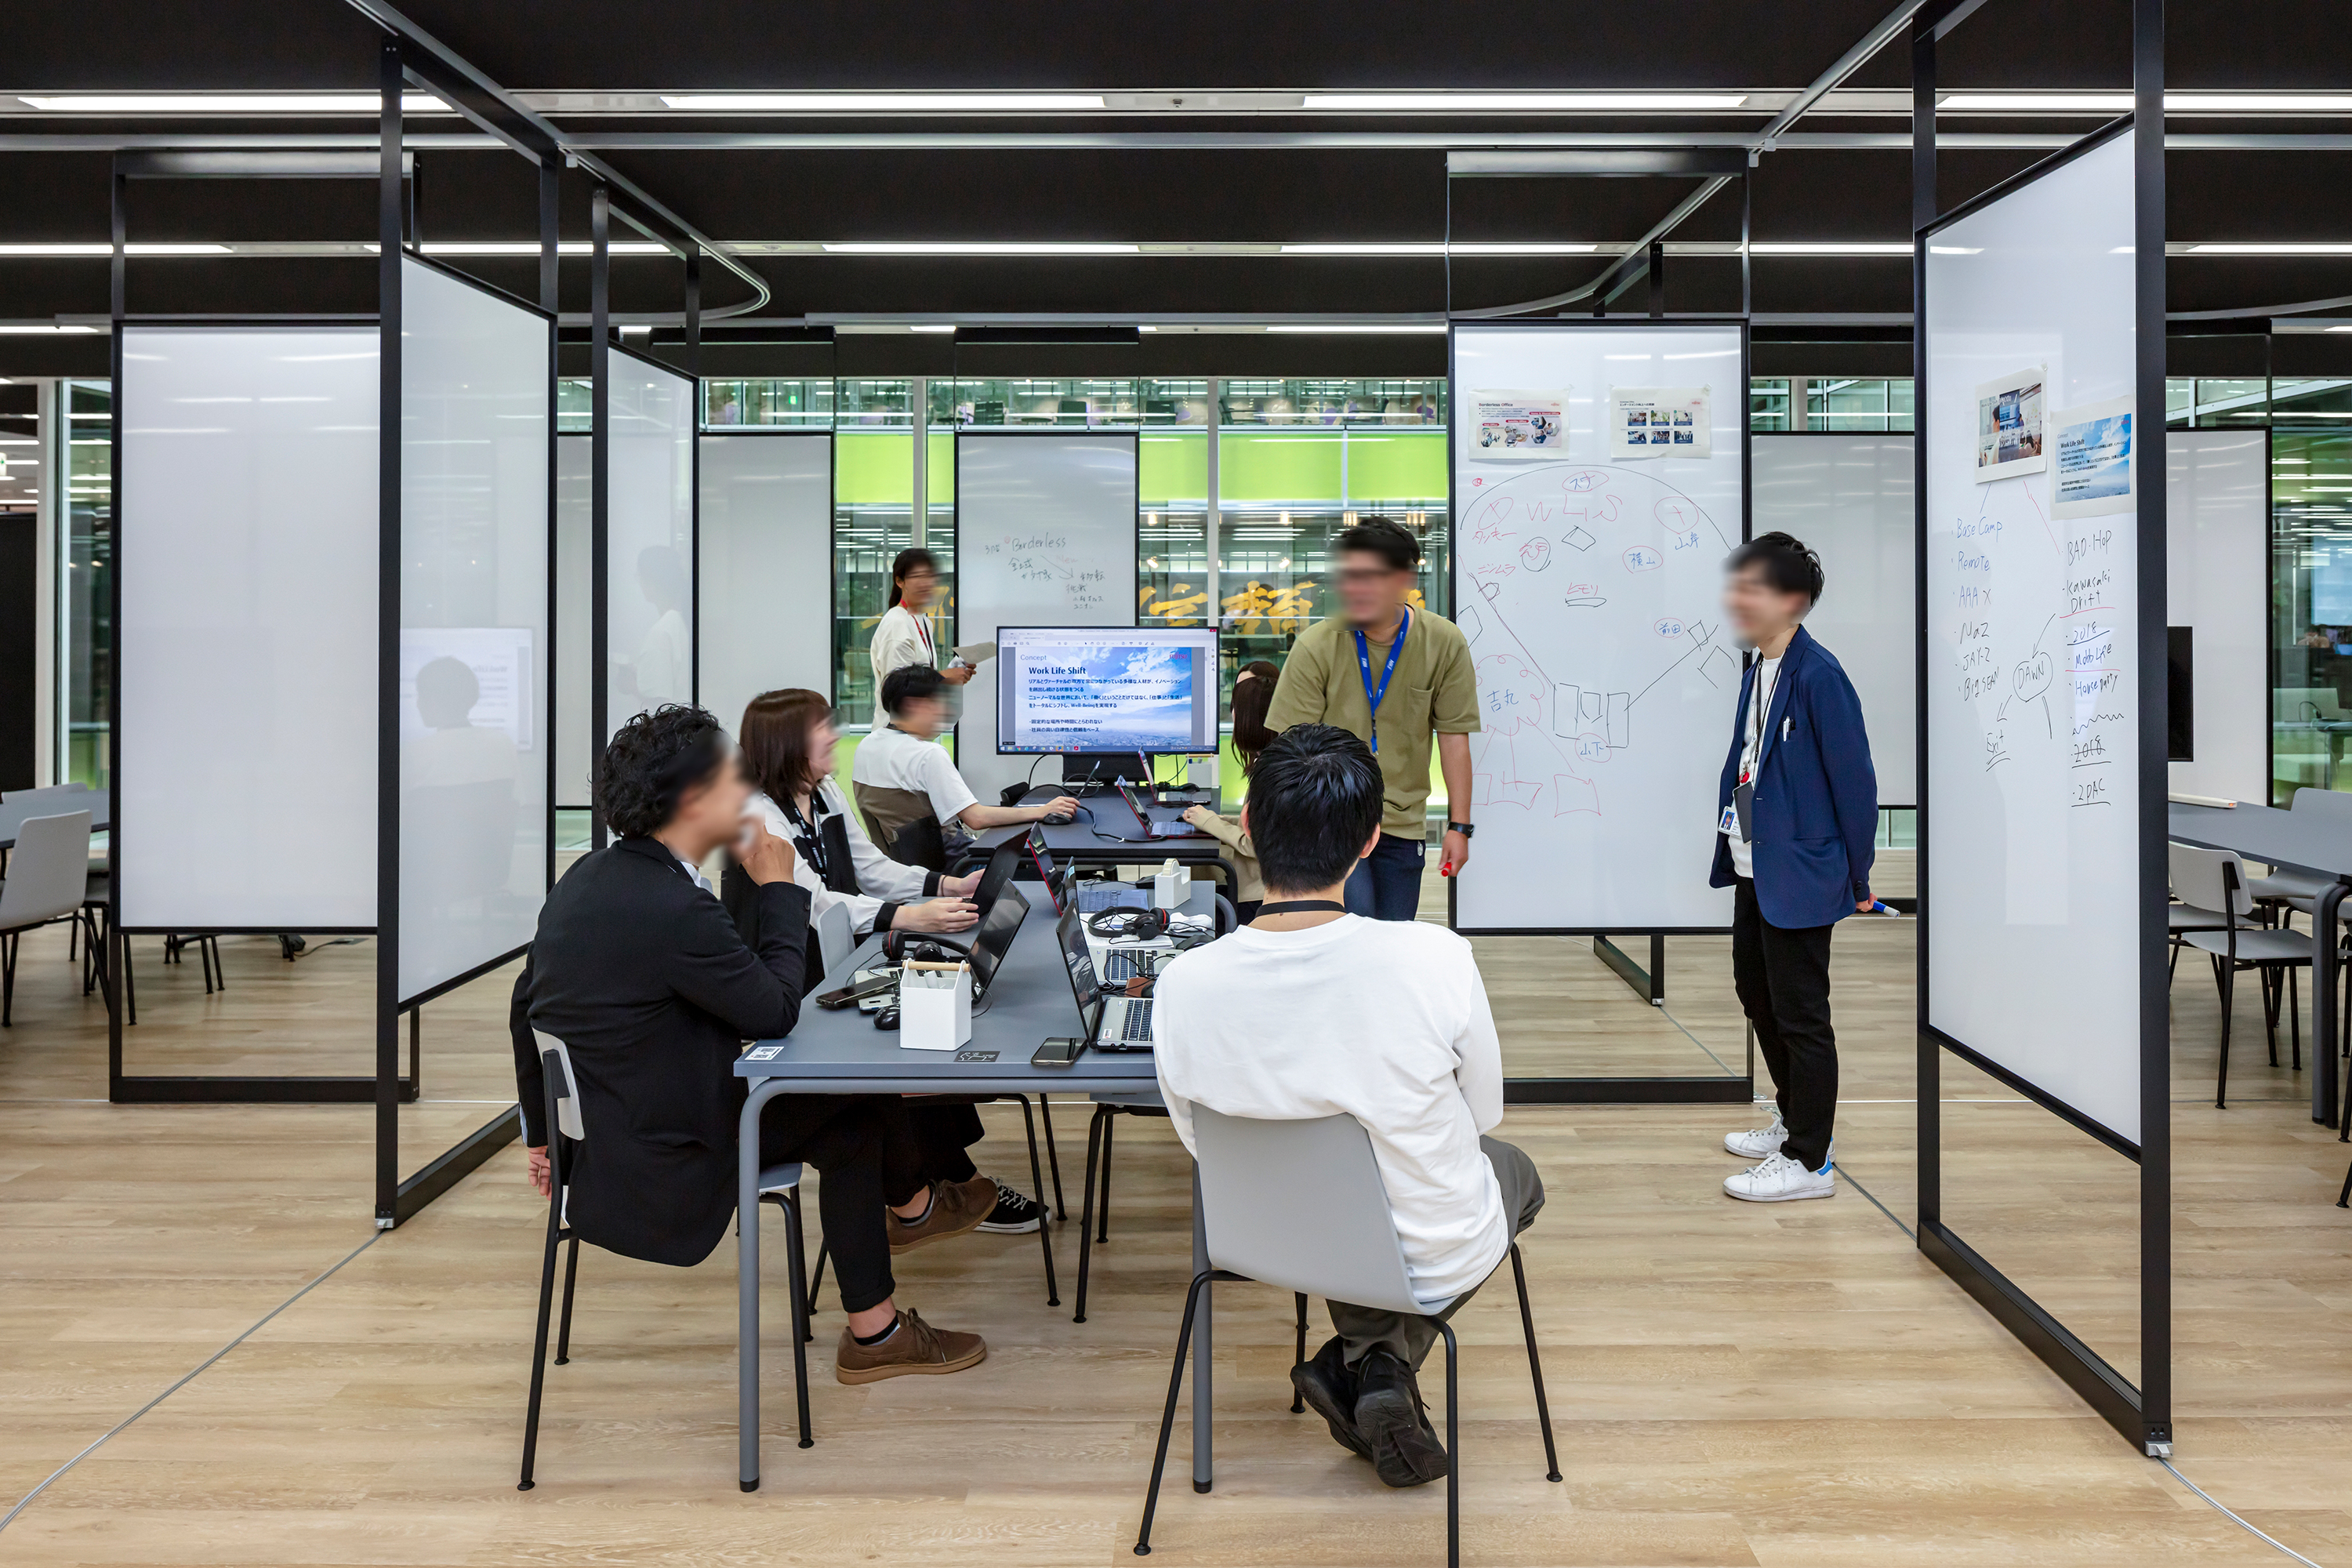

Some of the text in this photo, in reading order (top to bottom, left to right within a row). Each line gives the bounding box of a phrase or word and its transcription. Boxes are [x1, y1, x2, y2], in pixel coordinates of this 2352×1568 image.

[1012, 532, 1066, 552] Borderless
[1628, 552, 1655, 569] 横山
[2071, 590, 2101, 613] Drift
[2073, 621, 2097, 643] 2018
[1169, 652, 1188, 660] FUJITSU
[2017, 660, 2044, 690] DAWN
